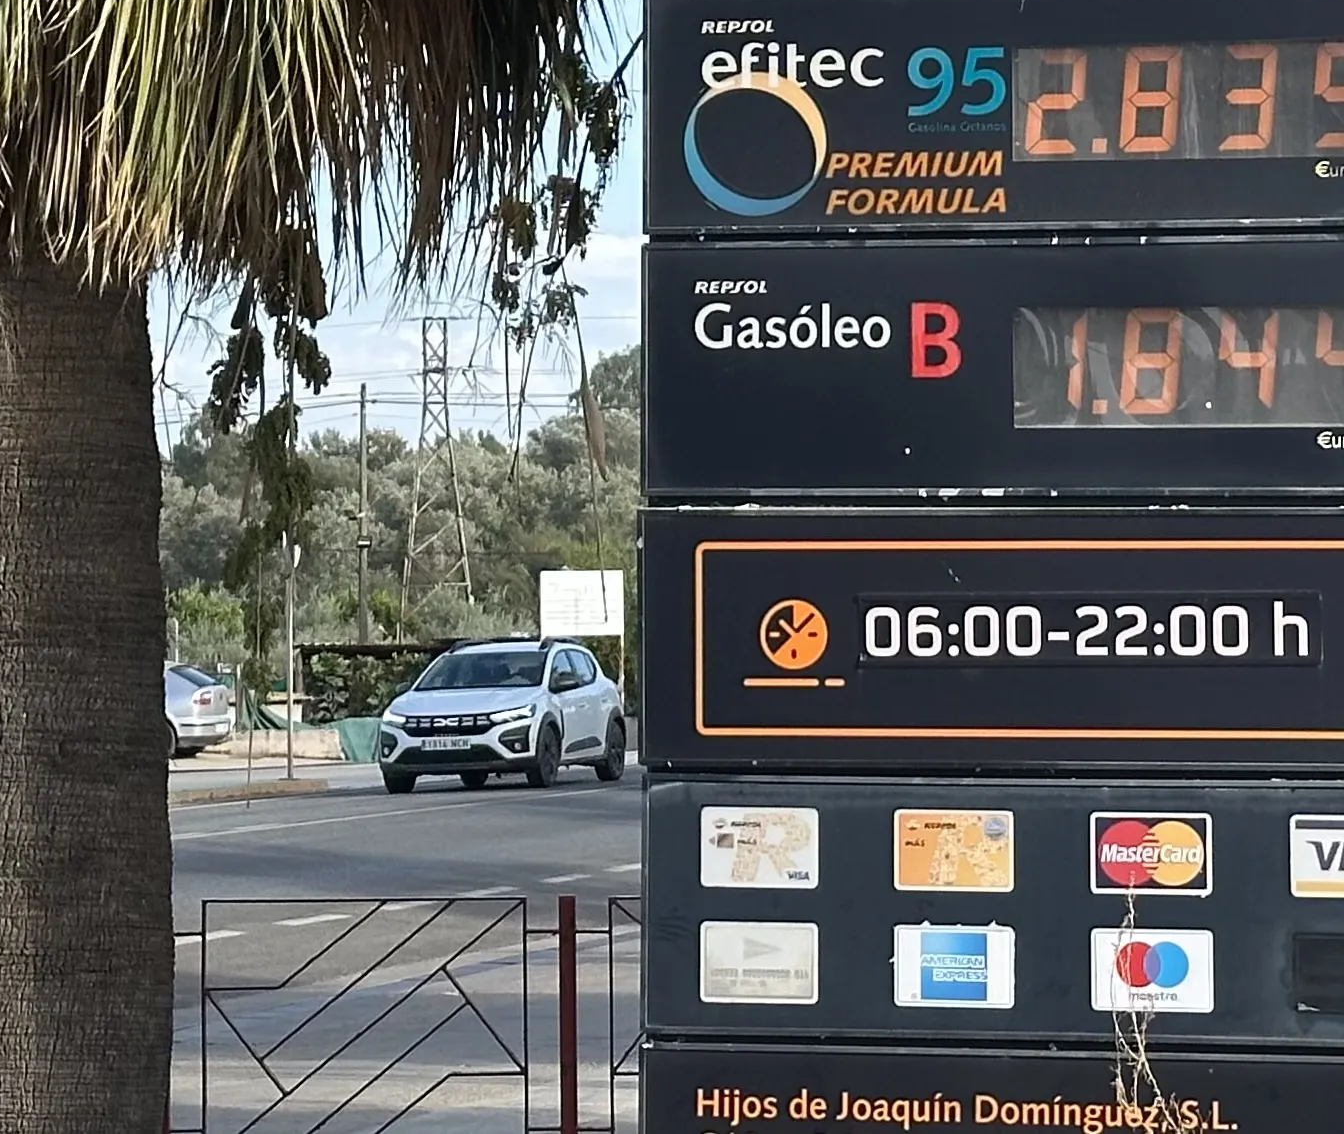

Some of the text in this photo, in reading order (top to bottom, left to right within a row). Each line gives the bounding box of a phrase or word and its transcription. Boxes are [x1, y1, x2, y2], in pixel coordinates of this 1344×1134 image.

[701, 19, 775, 35] REPSOL
[701, 42, 1006, 117] efitec 95
[826, 151, 1004, 178] PREMIUM
[826, 188, 1006, 215] FORMULA
[695, 280, 768, 295] REPSOL
[694, 301, 963, 379] Gasóleo B
[863, 601, 1310, 658] 06:00-22:00 h
[1099, 842, 1202, 864] MasterCard
[921, 956, 983, 966] AMERICAN
[935, 969, 988, 980] EXPRESS
[695, 1088, 778, 1126] Hijos
[788, 1088, 827, 1120] de
[836, 1091, 962, 1130] Joaquín
